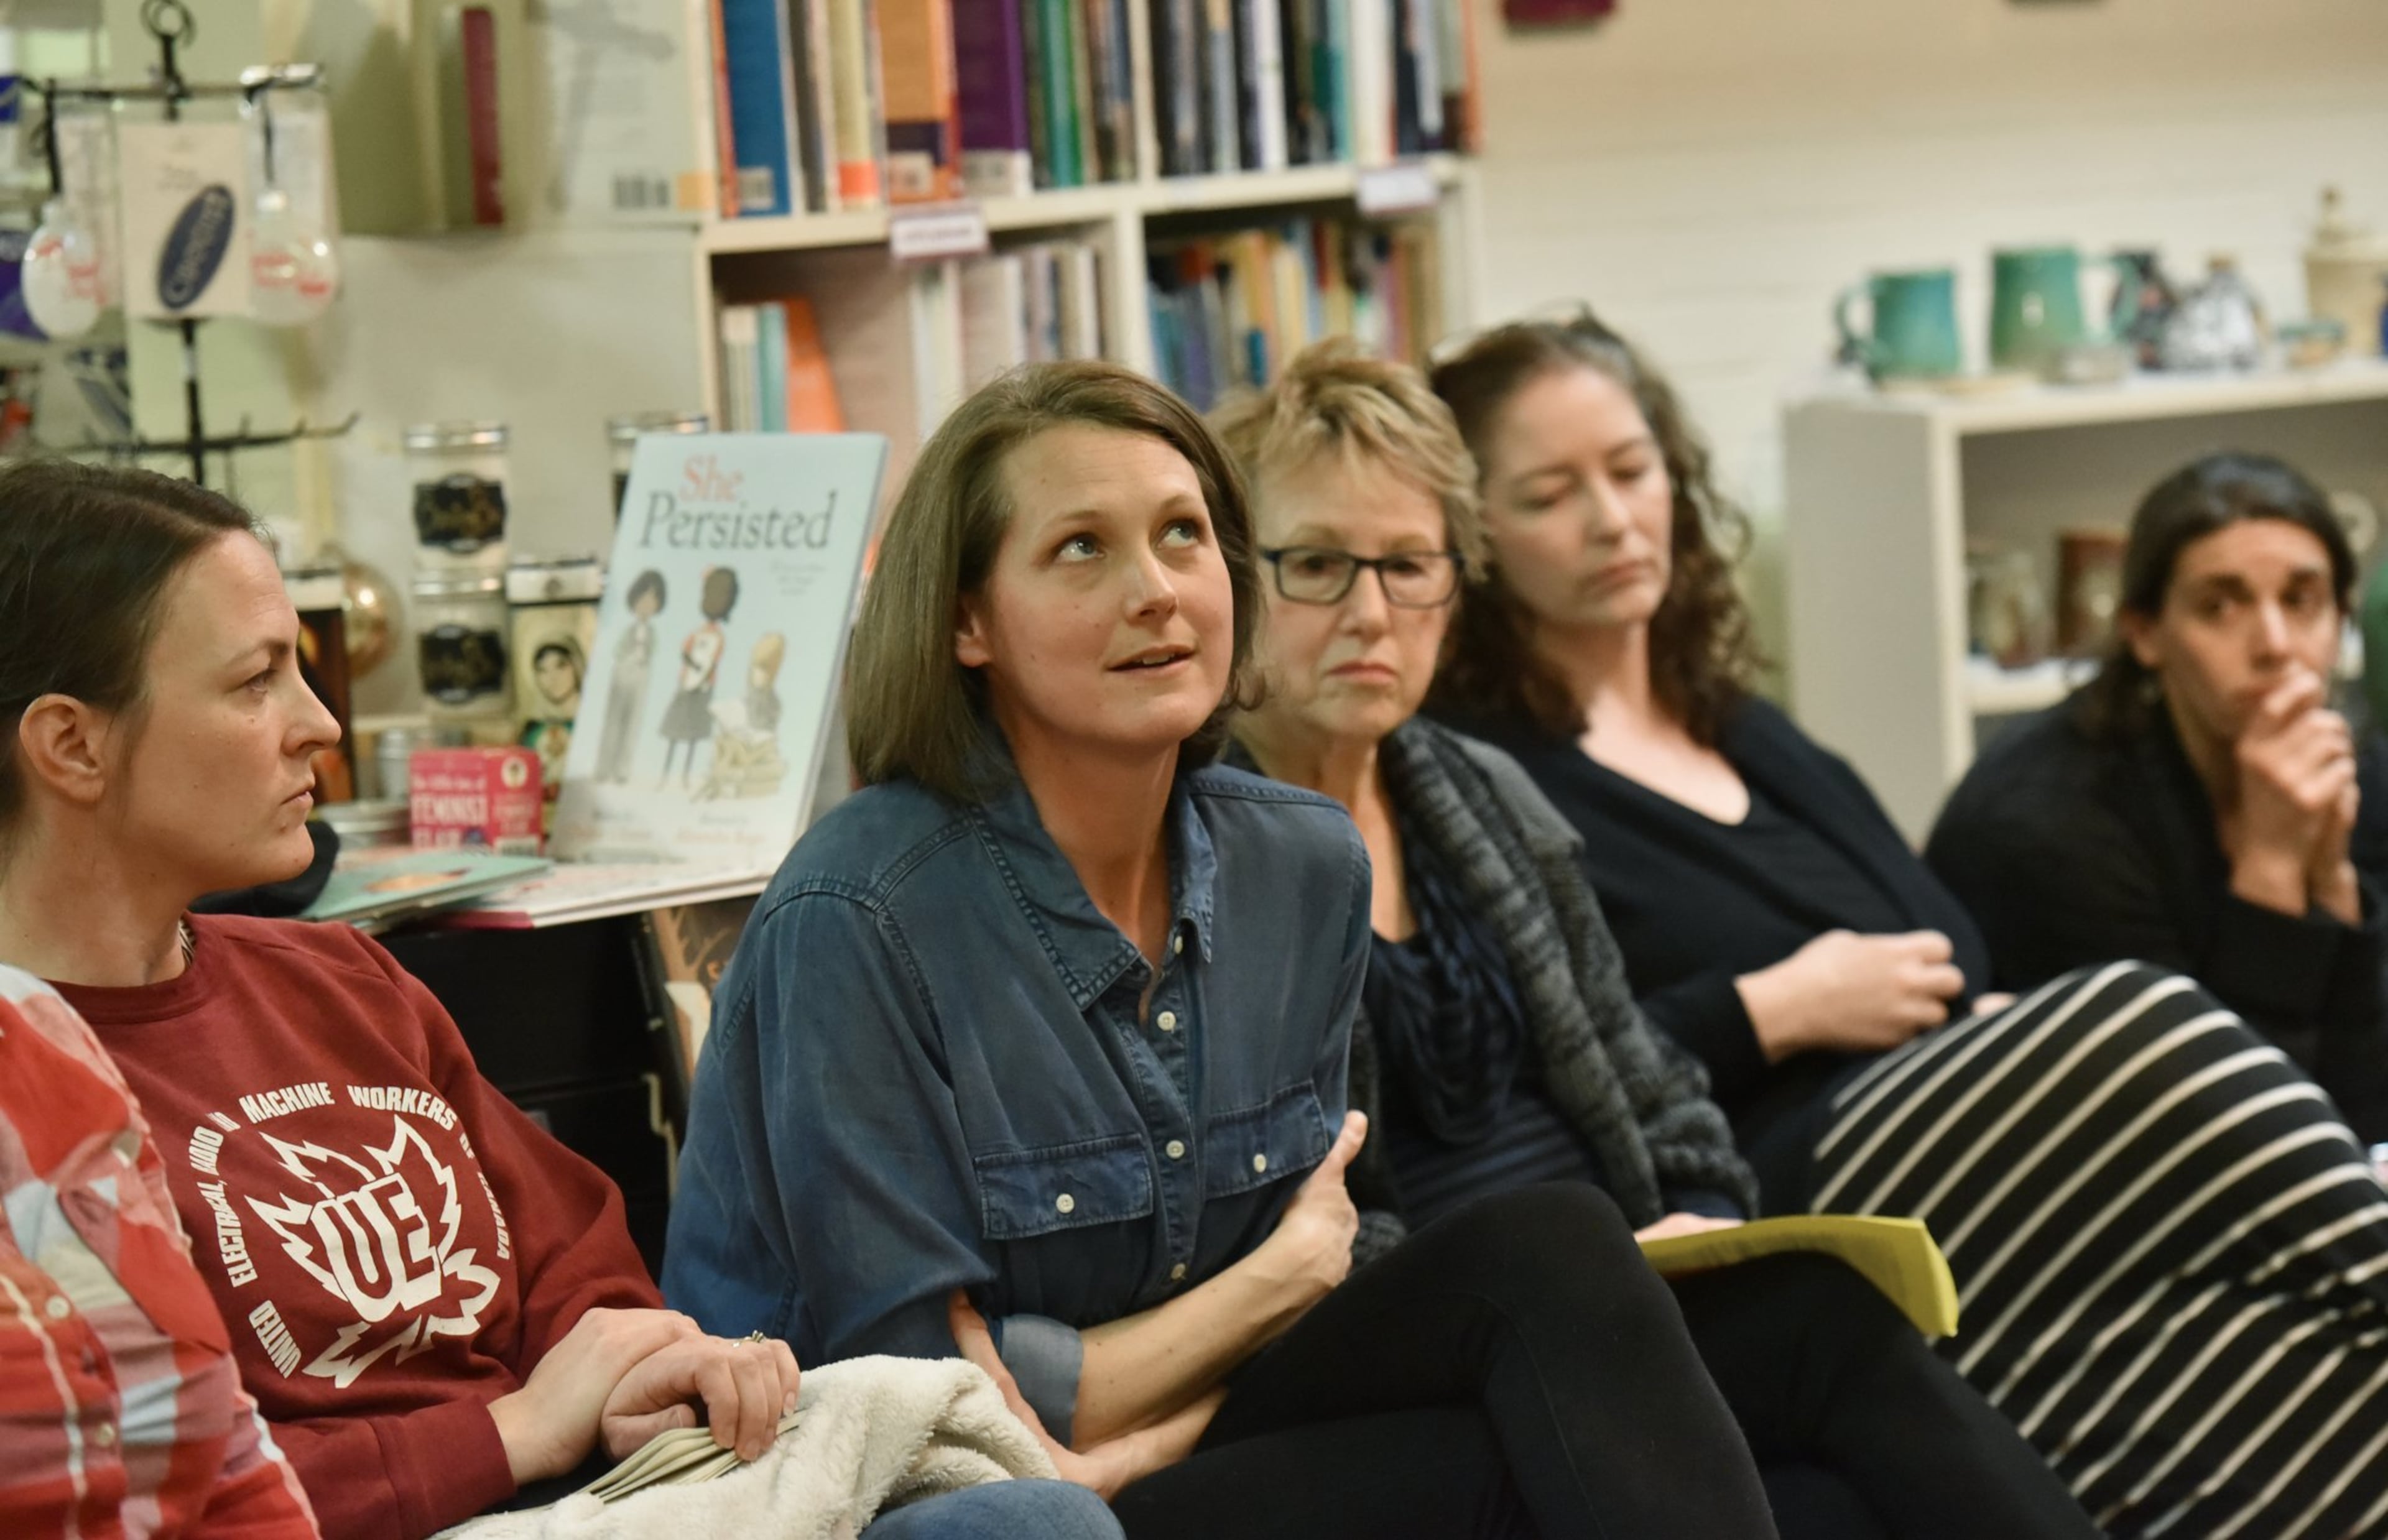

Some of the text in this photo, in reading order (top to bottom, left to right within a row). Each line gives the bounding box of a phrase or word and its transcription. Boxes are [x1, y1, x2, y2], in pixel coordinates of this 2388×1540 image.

[679, 454, 744, 502] She
[641, 489, 837, 548] Persisted
[239, 1082, 335, 1124] MACHINE
[347, 1085, 457, 1131] WORKERS
[197, 1179, 258, 1288] ELECTRCAL,
[310, 1173, 442, 1322] UE
[249, 1299, 302, 1379] UNITED
